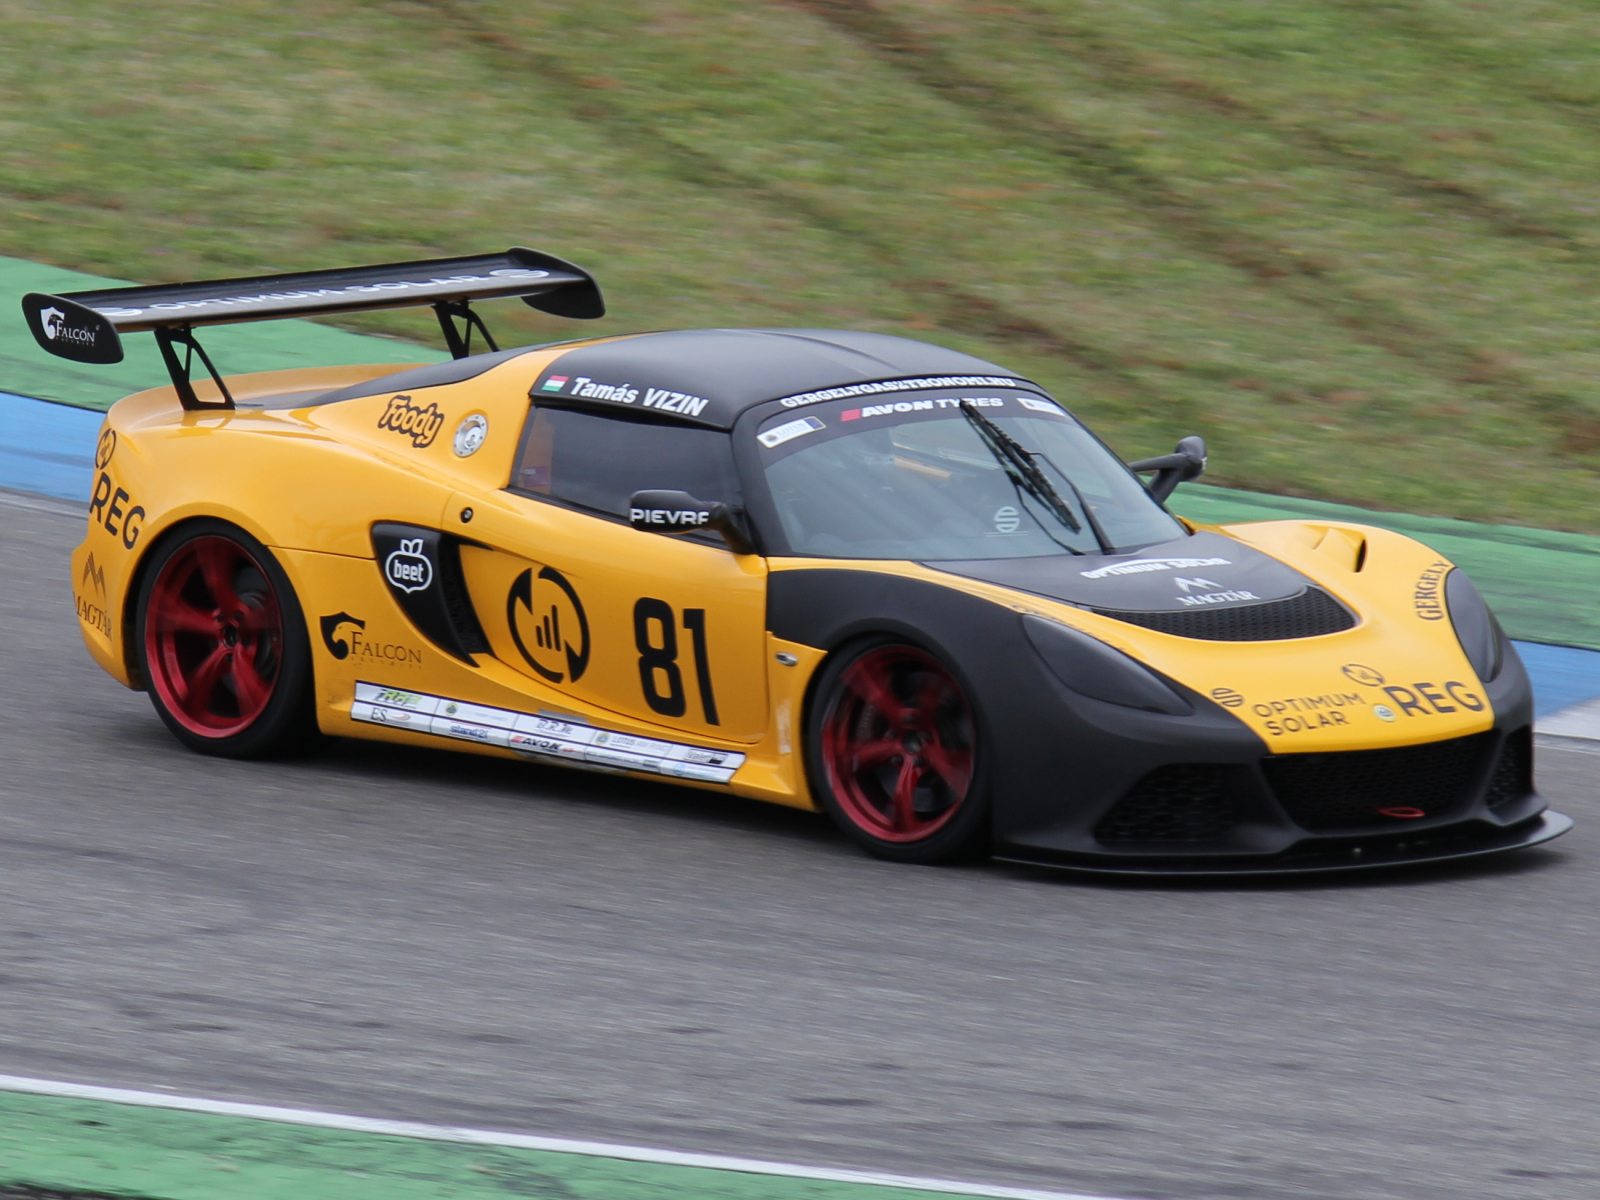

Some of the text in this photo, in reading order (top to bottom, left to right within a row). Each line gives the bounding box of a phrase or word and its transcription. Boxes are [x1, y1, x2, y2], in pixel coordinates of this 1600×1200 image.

[55, 319, 96, 343] FALCON
[569, 376, 709, 417] Tamás VIZIN
[861, 397, 1004, 418] AVON TYRES
[378, 395, 445, 448] Foody
[89, 471, 146, 550] REG
[393, 559, 425, 583] beet
[1176, 589, 1262, 607] MAGTÁR
[1414, 560, 1450, 621] GERGELY
[73, 592, 113, 642] AGTÁR
[351, 631, 422, 663] FALCON
[632, 597, 721, 727] 81
[1253, 692, 1367, 718] OPTIMUM
[1382, 681, 1486, 717] REG
[1264, 711, 1351, 736] SOLAR
